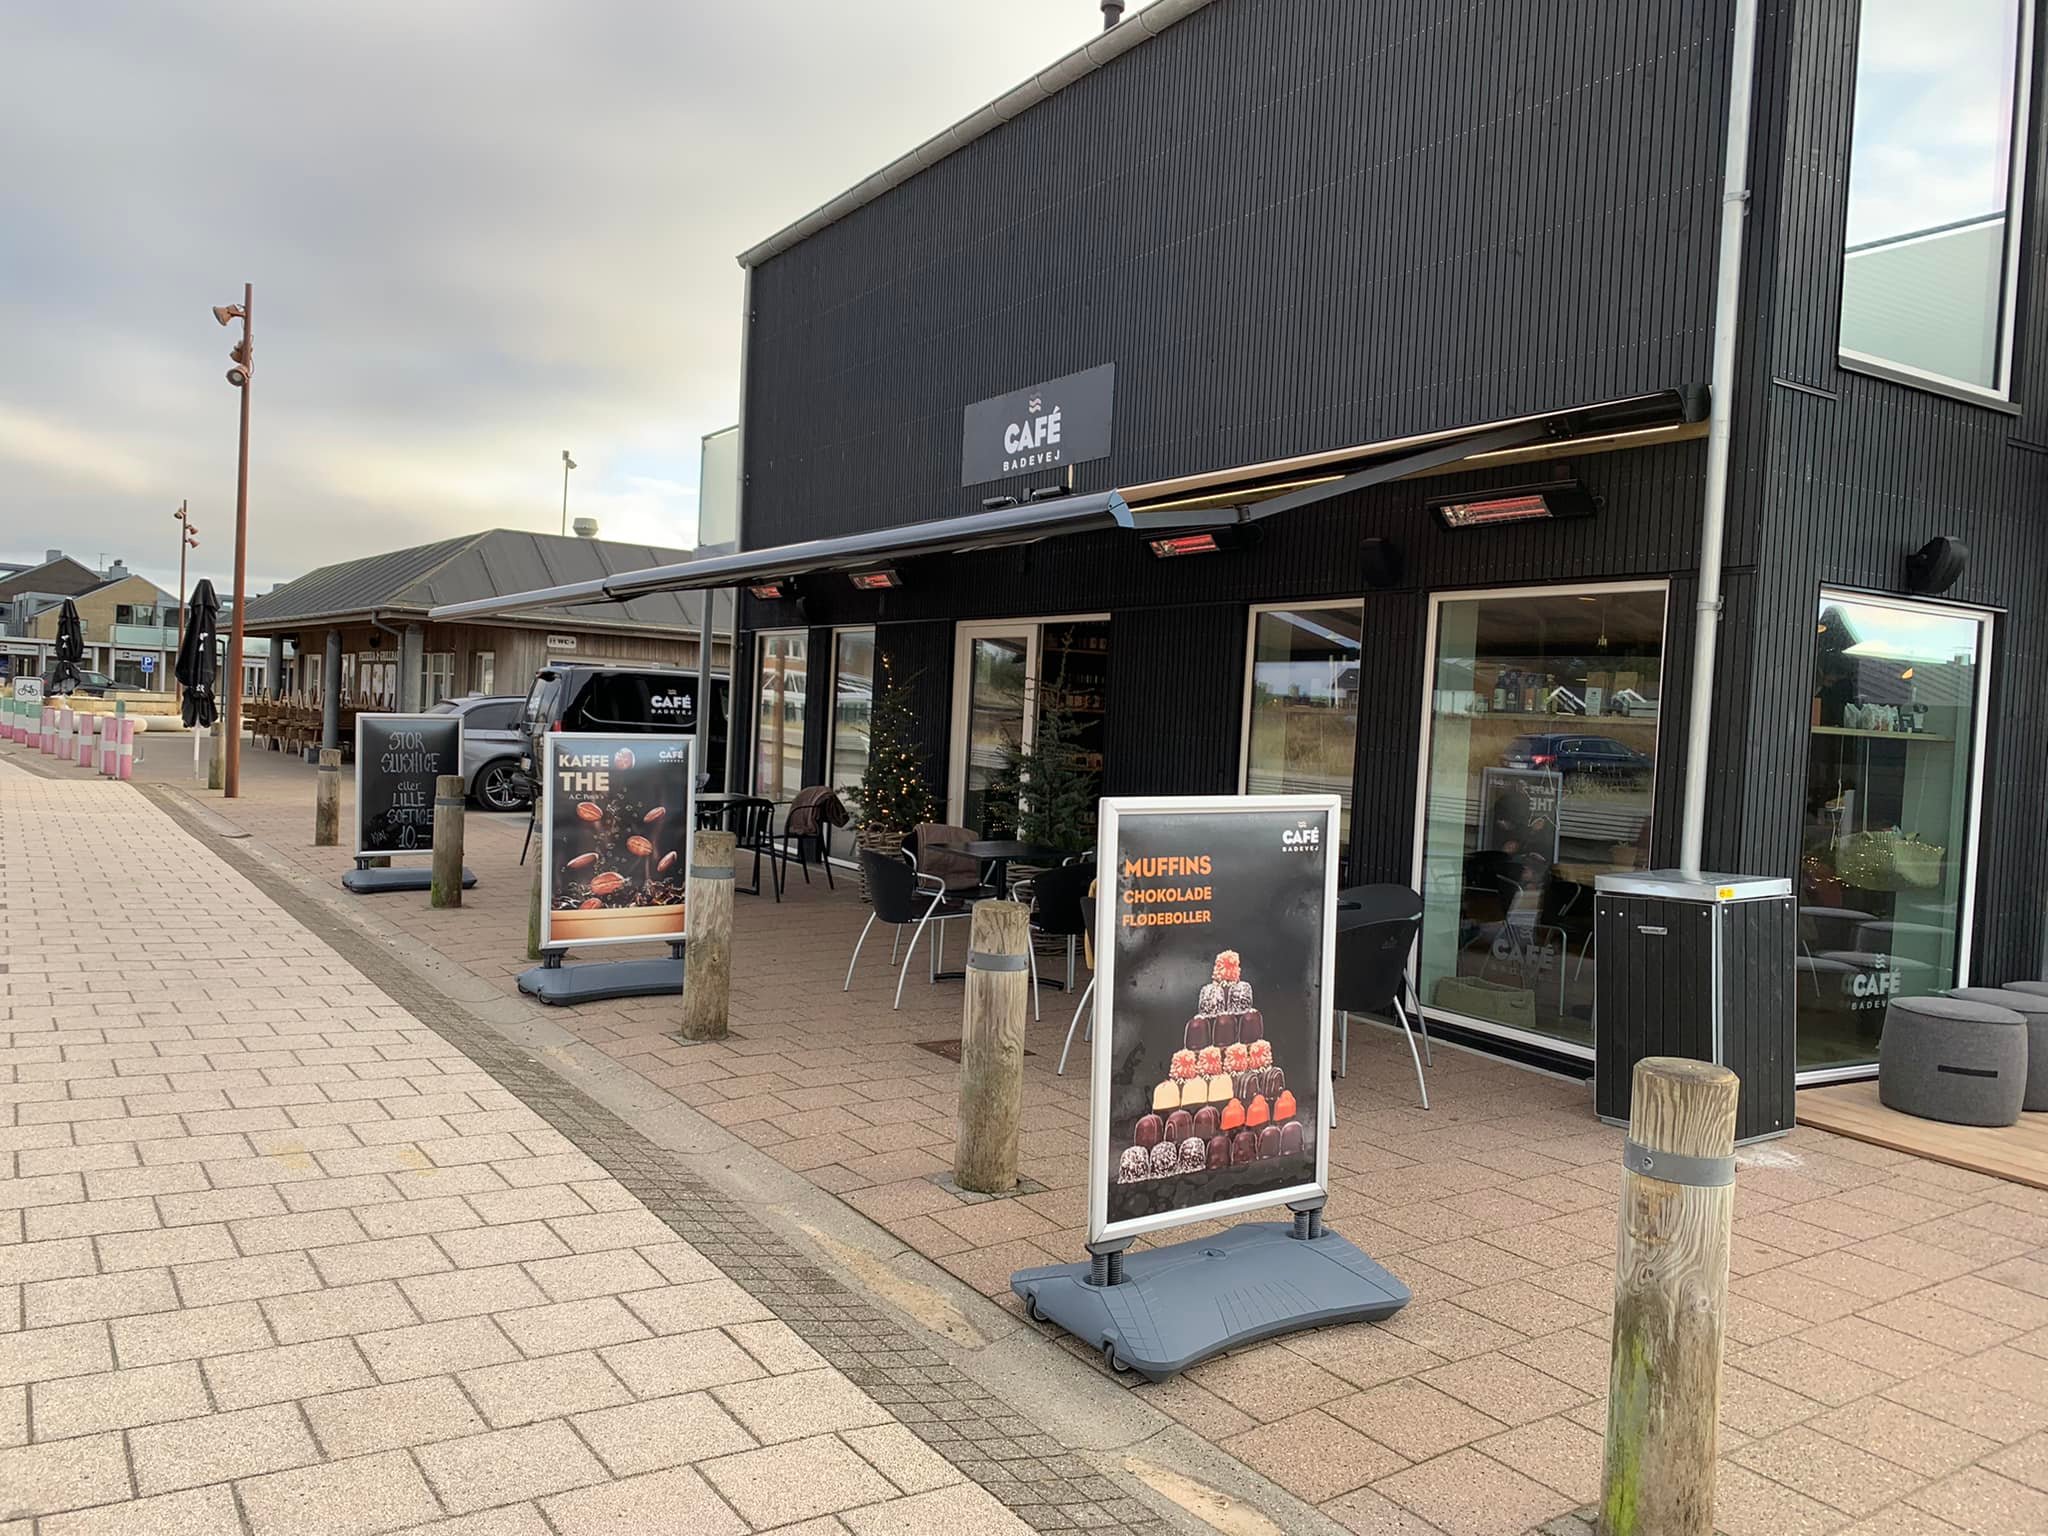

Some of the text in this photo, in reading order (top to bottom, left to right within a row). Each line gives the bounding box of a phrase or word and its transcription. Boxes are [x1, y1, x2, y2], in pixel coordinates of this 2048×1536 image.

[1004, 405, 1061, 454] CAFÉ
[1003, 449, 1060, 471] BADEVEJ
[651, 694, 692, 708] CAFÉ
[389, 731, 426, 754] STOR
[559, 754, 609, 768] KAFFE
[397, 781, 421, 791] eller
[559, 771, 609, 792] THE
[392, 791, 426, 807] LILLE
[386, 808, 434, 824] SOFTICE
[1282, 827, 1319, 844] CAFÉ
[1124, 855, 1212, 878] MUFFINS
[1123, 886, 1212, 904] CHOKOLADE
[1122, 910, 1211, 927] FLØDEBOLLER
[1853, 968, 1901, 997] CAFÉ
[1851, 1000, 1888, 1010] BADEV
